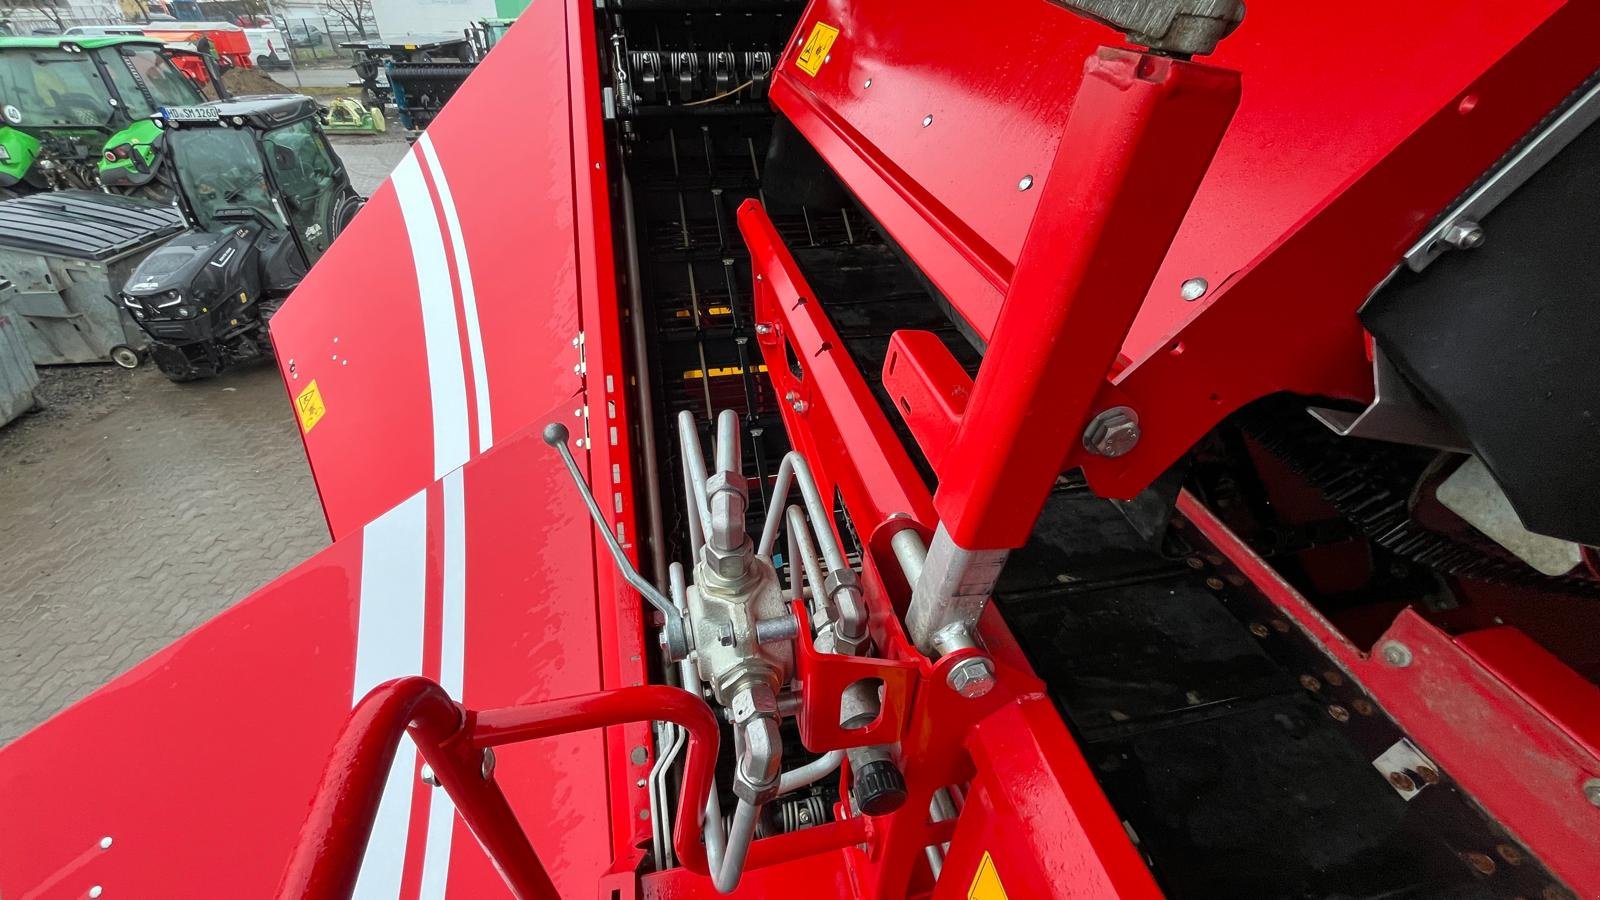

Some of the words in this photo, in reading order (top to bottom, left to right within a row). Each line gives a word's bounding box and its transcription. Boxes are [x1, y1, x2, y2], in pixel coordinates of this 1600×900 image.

[167, 108, 180, 118] HD
[183, 108, 196, 118] SM
[196, 108, 217, 118] 1260
